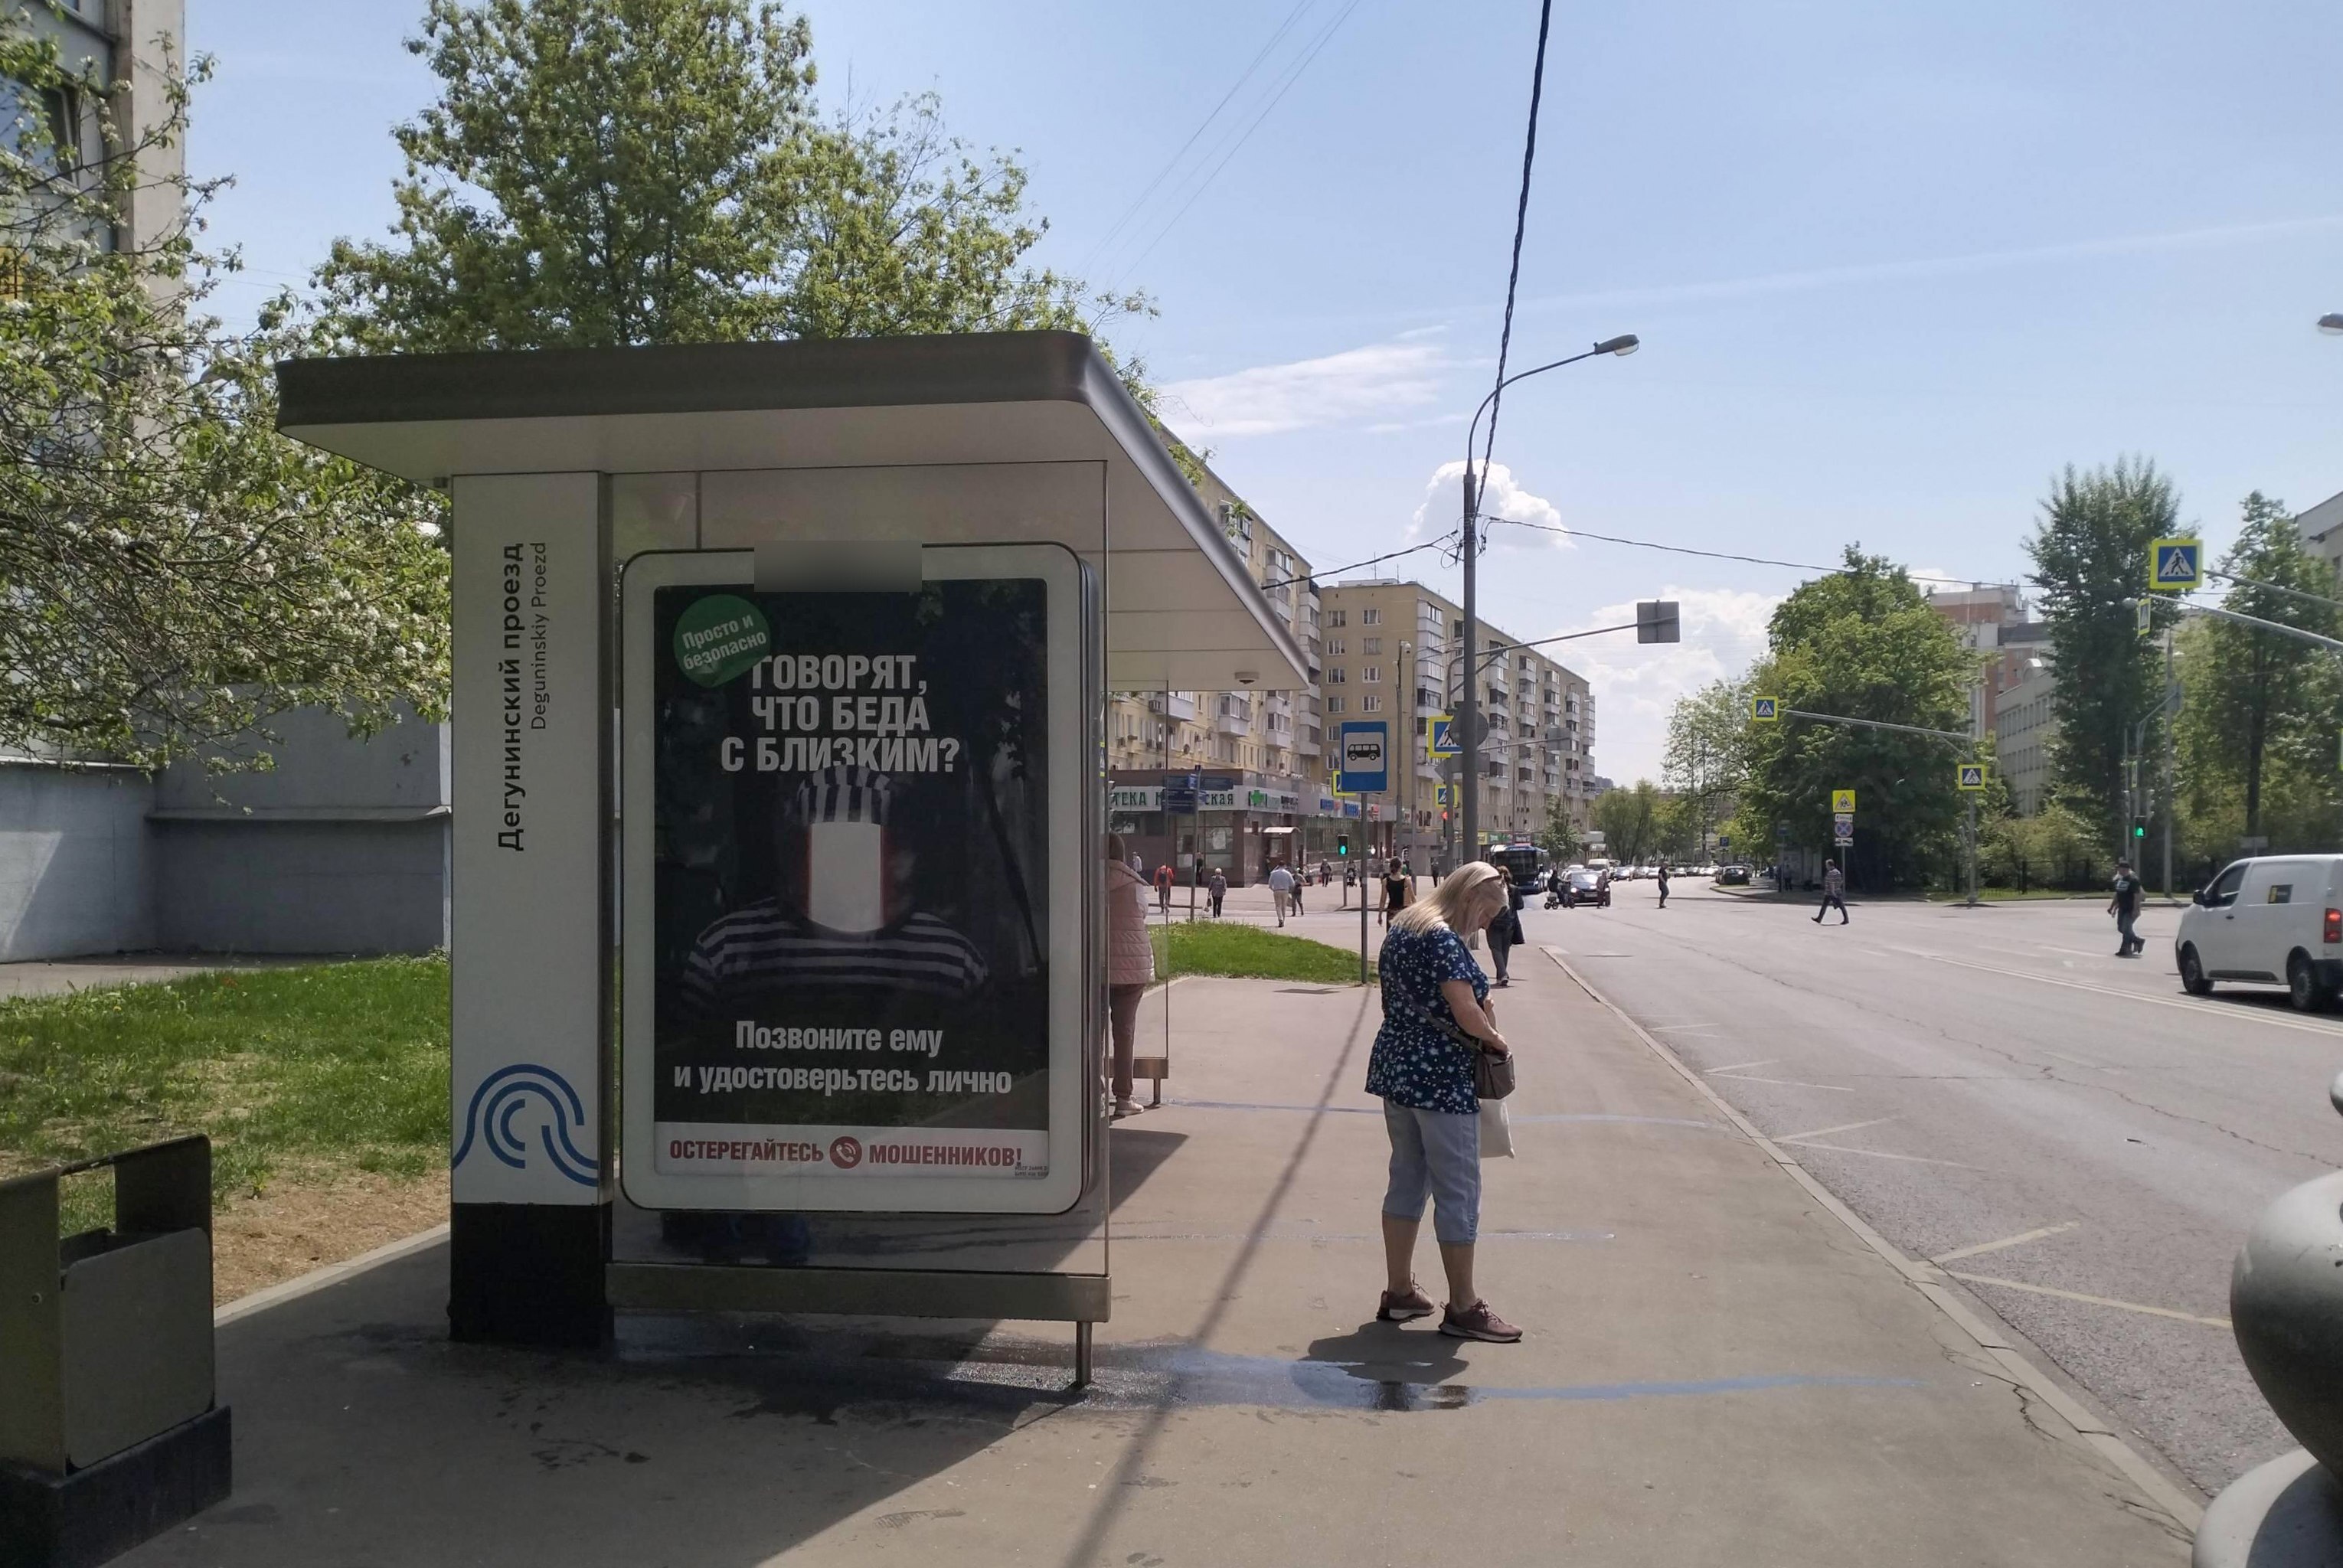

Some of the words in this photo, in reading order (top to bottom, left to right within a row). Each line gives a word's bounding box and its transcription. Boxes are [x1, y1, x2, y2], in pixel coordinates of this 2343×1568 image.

[530, 542, 547, 608] Proezd
[503, 544, 525, 649] проезд
[682, 622, 739, 648] Просто
[743, 615, 754, 630] и
[683, 632, 766, 670] безопасно
[531, 613, 550, 730] Deguninskiy
[753, 655, 926, 694] ГОВОРЯТ,
[753, 696, 819, 731] ЧТО
[832, 696, 930, 737] БЕДА
[498, 660, 525, 851] Дегунинский
[721, 737, 745, 772] С
[756, 737, 960, 773] БЛИЗКИМ?
[736, 1021, 881, 1050] Позвоните
[890, 1029, 943, 1057] ему
[675, 1067, 691, 1087] и
[700, 1065, 919, 1096] удостоверьтесь
[926, 1070, 1012, 1093] лично
[669, 1138, 824, 1163] ОСТЕРЕГАЙТЕСЬ
[869, 1144, 1022, 1168] МОШЕННИКОВ!
